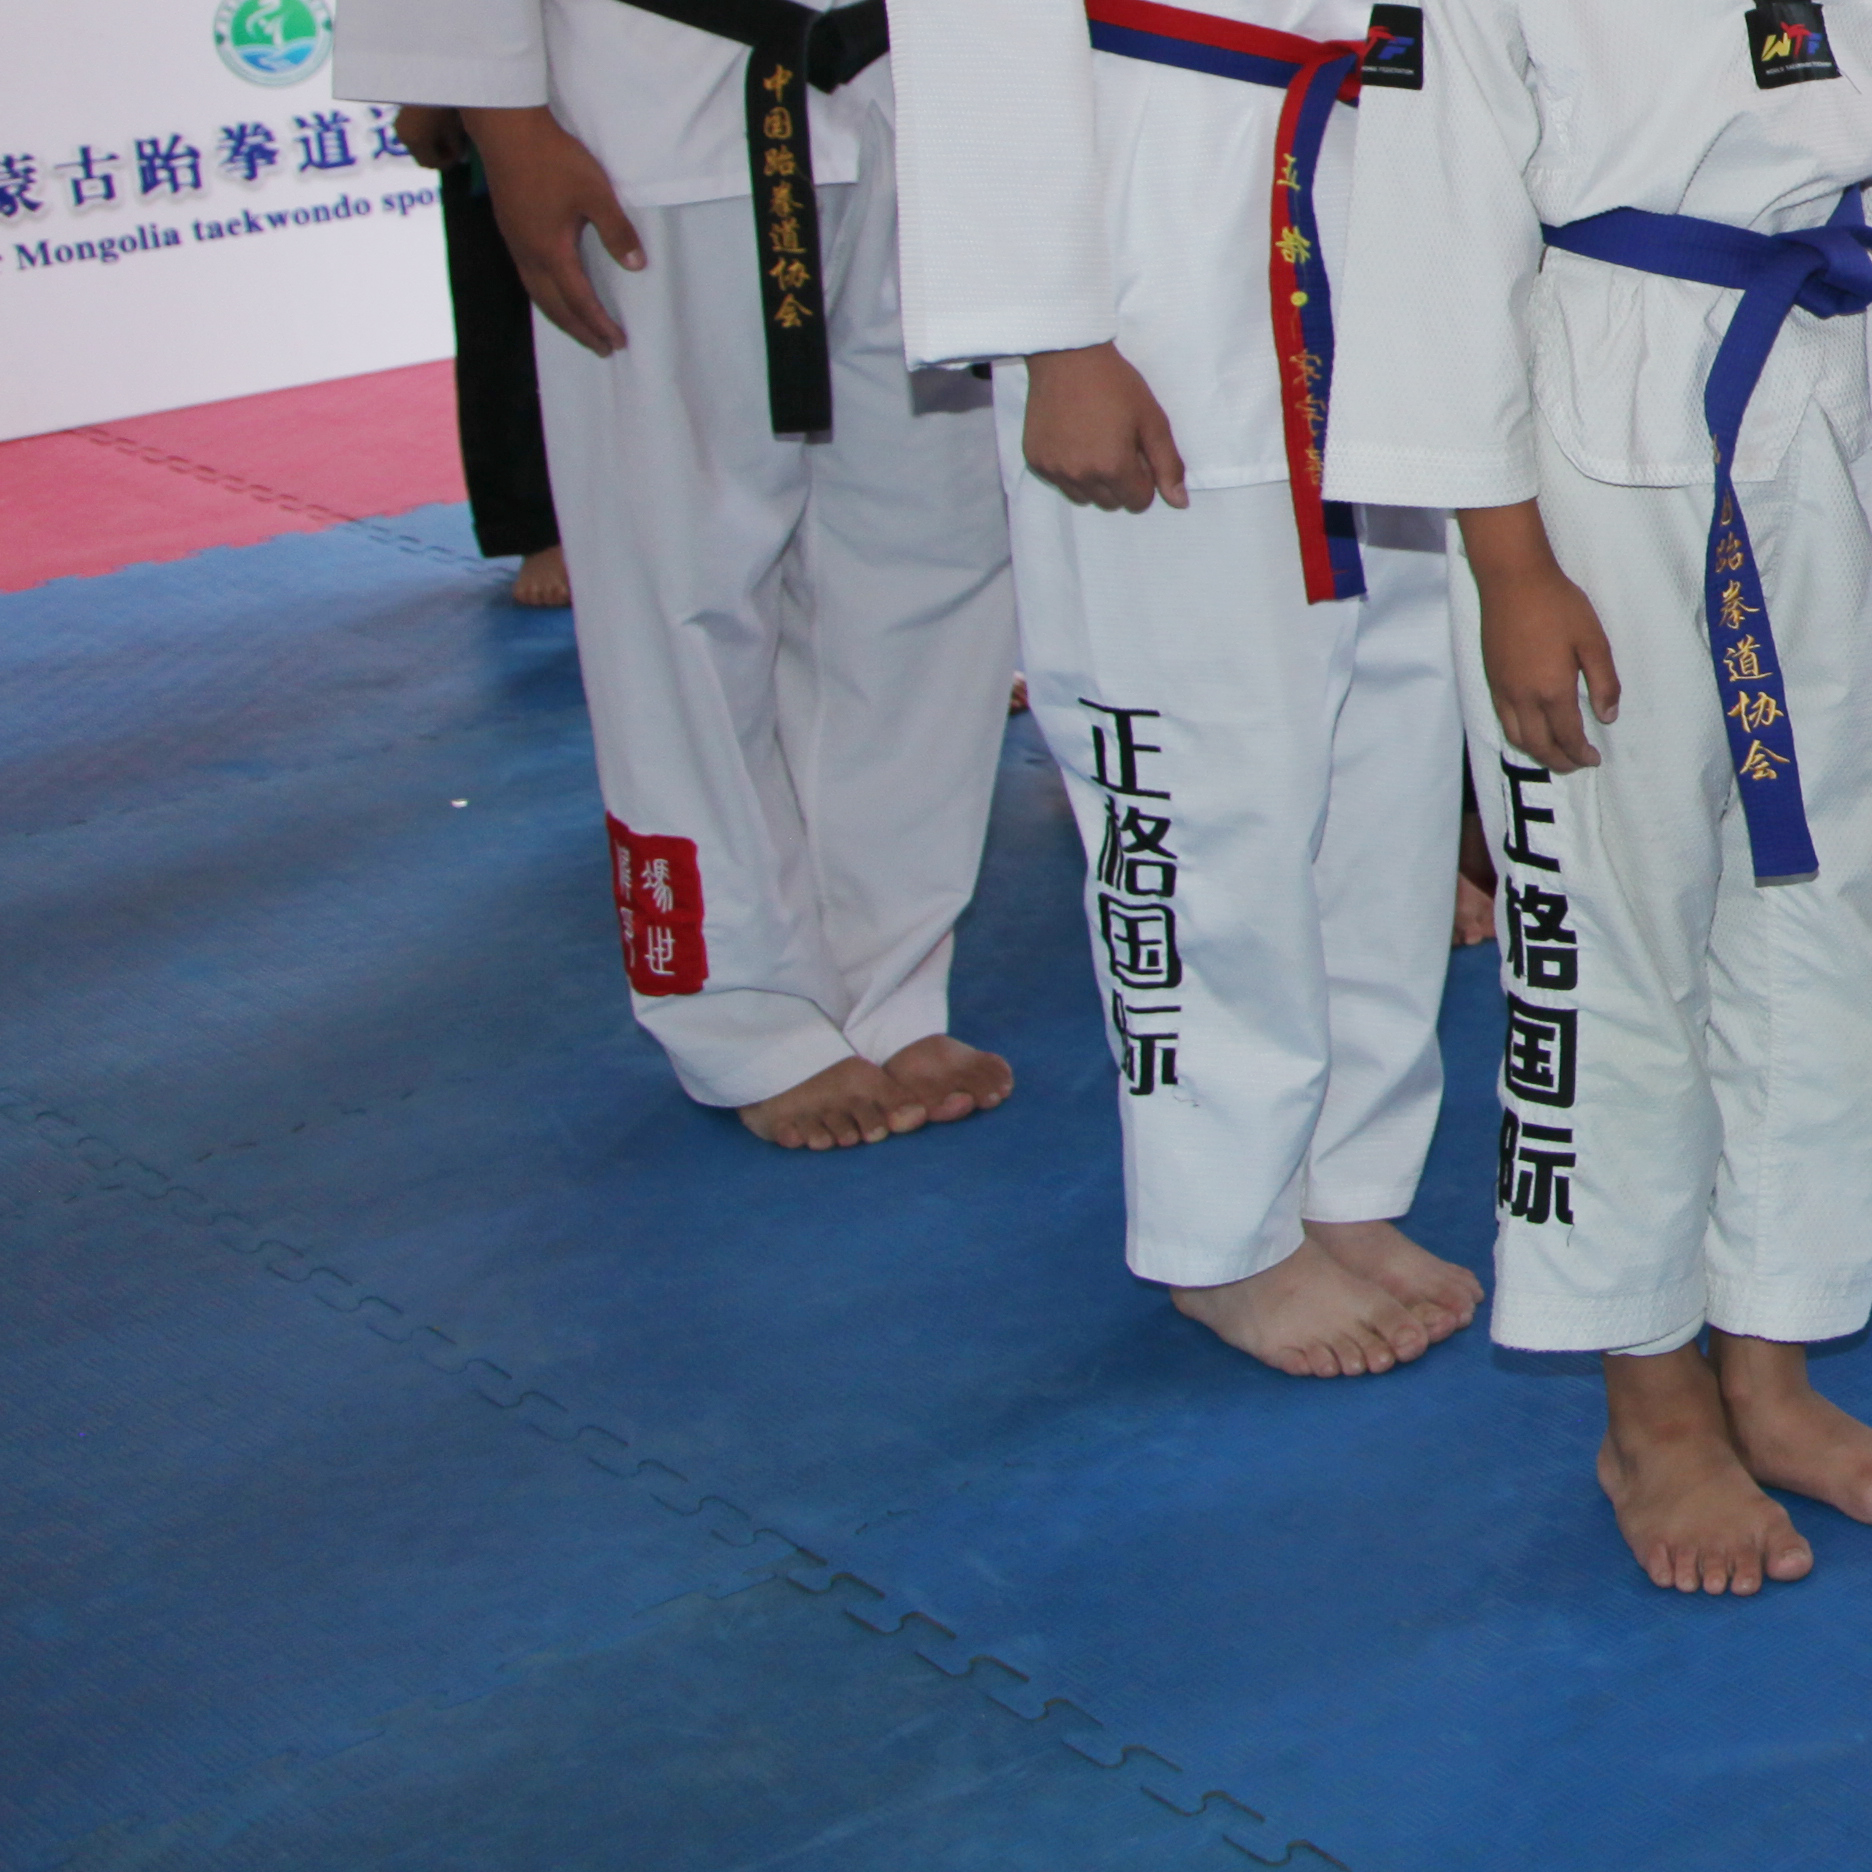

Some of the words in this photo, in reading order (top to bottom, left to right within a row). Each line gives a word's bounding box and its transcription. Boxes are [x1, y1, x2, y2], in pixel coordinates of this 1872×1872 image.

[1761, 21, 1824, 62] WTF
[14, 222, 183, 271] Mongolia
[193, 193, 371, 242] taekwondo
[762, 64, 814, 328] 中国跆拳道协会
[1077, 696, 1183, 1096] 正格国际
